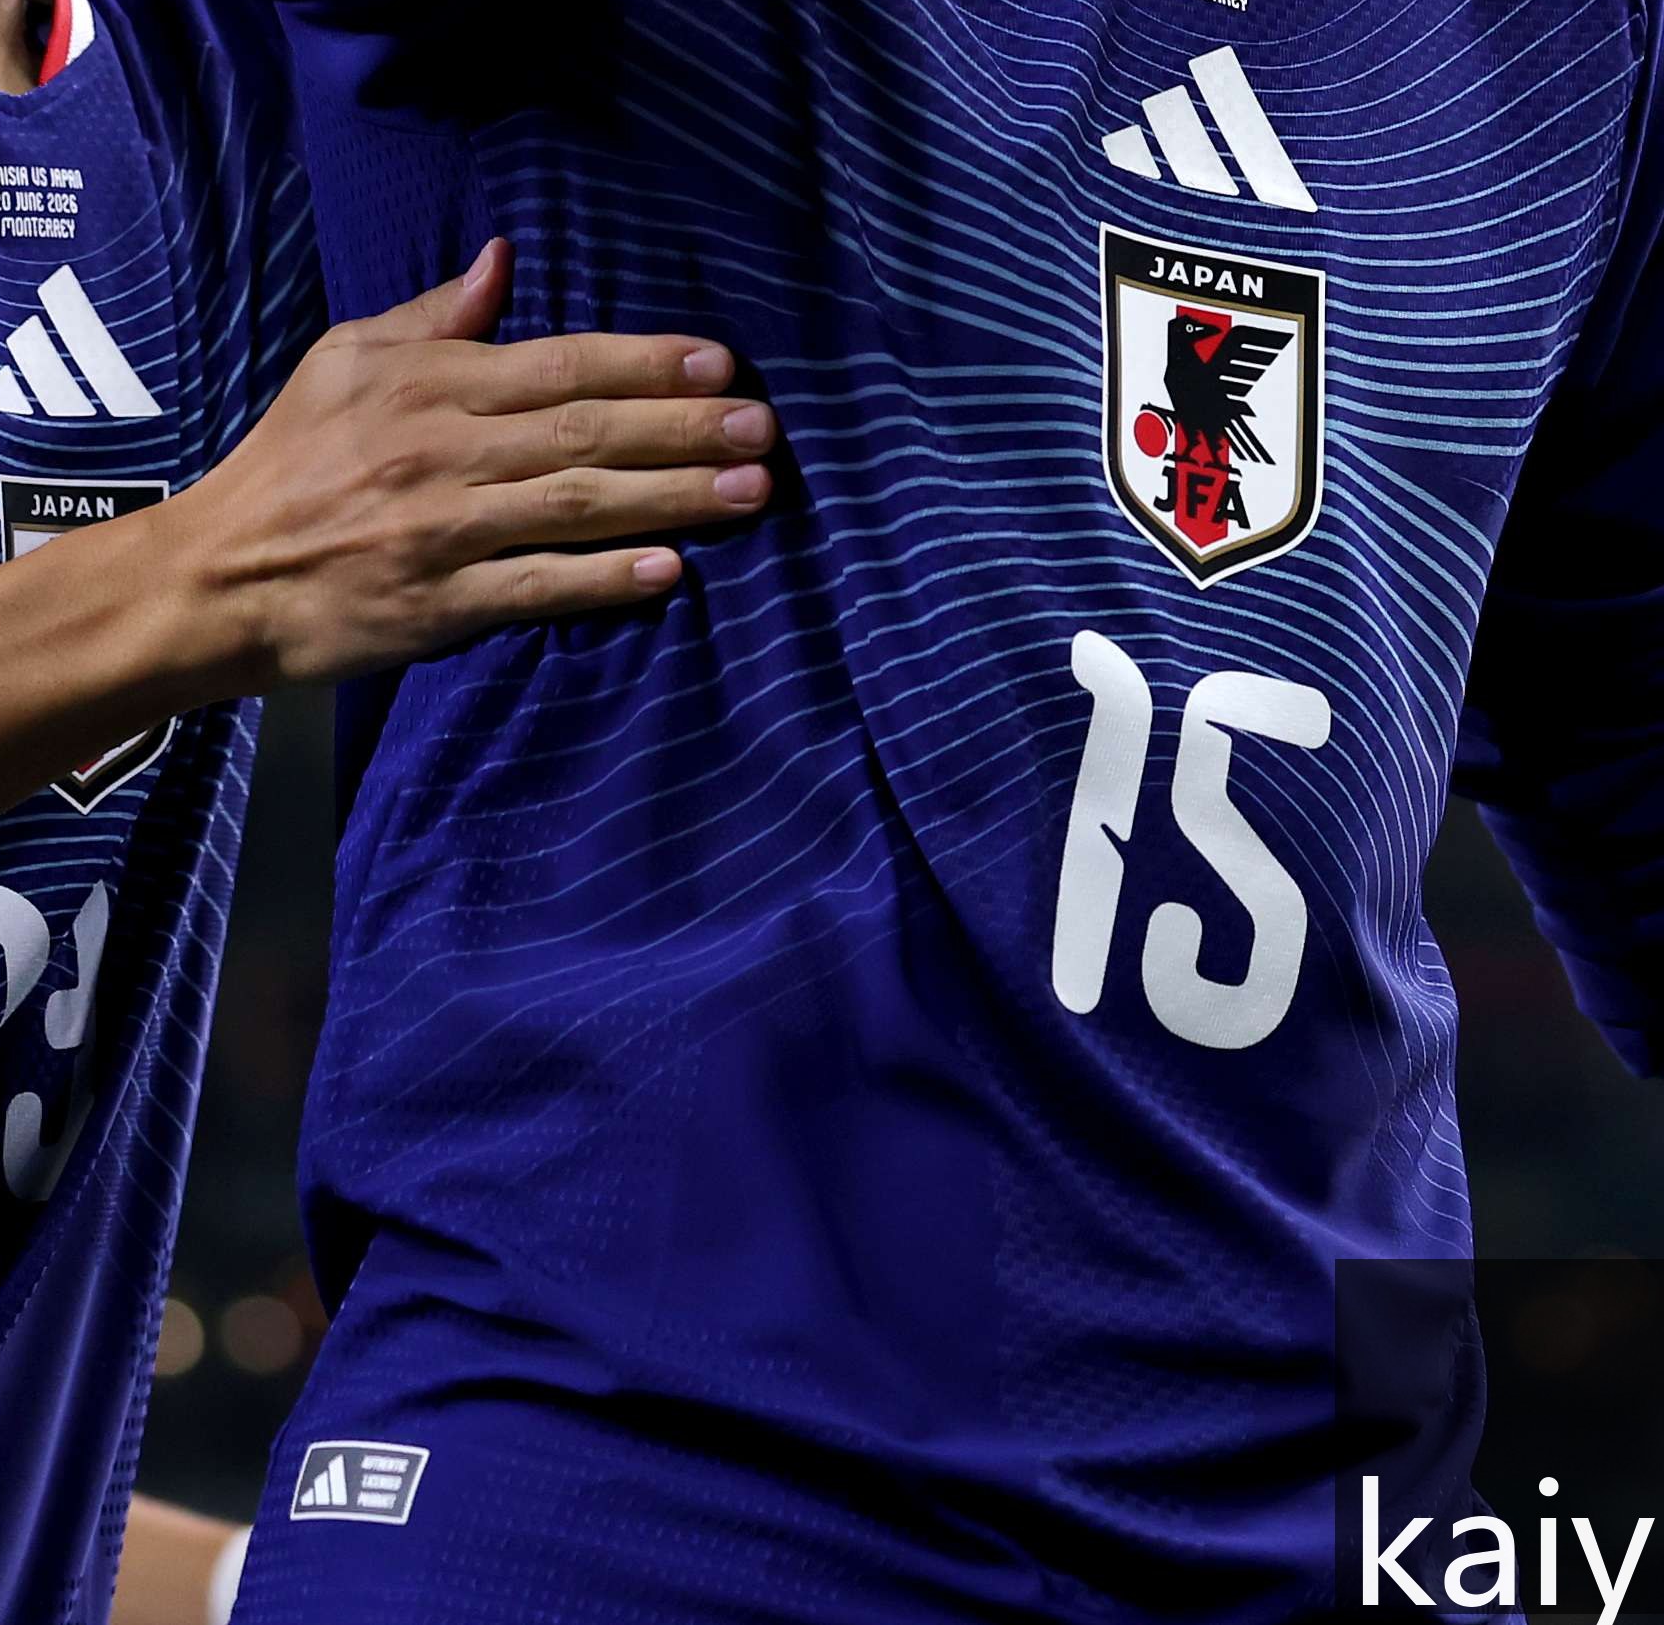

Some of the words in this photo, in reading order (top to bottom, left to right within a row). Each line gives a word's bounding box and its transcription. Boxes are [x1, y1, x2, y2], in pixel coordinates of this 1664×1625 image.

[49, 167, 84, 190] JAPAN
[15, 191, 45, 212] JUNE
[47, 192, 78, 214] 2026
[1, 216, 76, 239] MONTERREY
[1149, 256, 1264, 299] JAPAN
[30, 494, 114, 518] JAPAN
[1153, 465, 1252, 530] JFA
[1052, 629, 1332, 1049] 15
